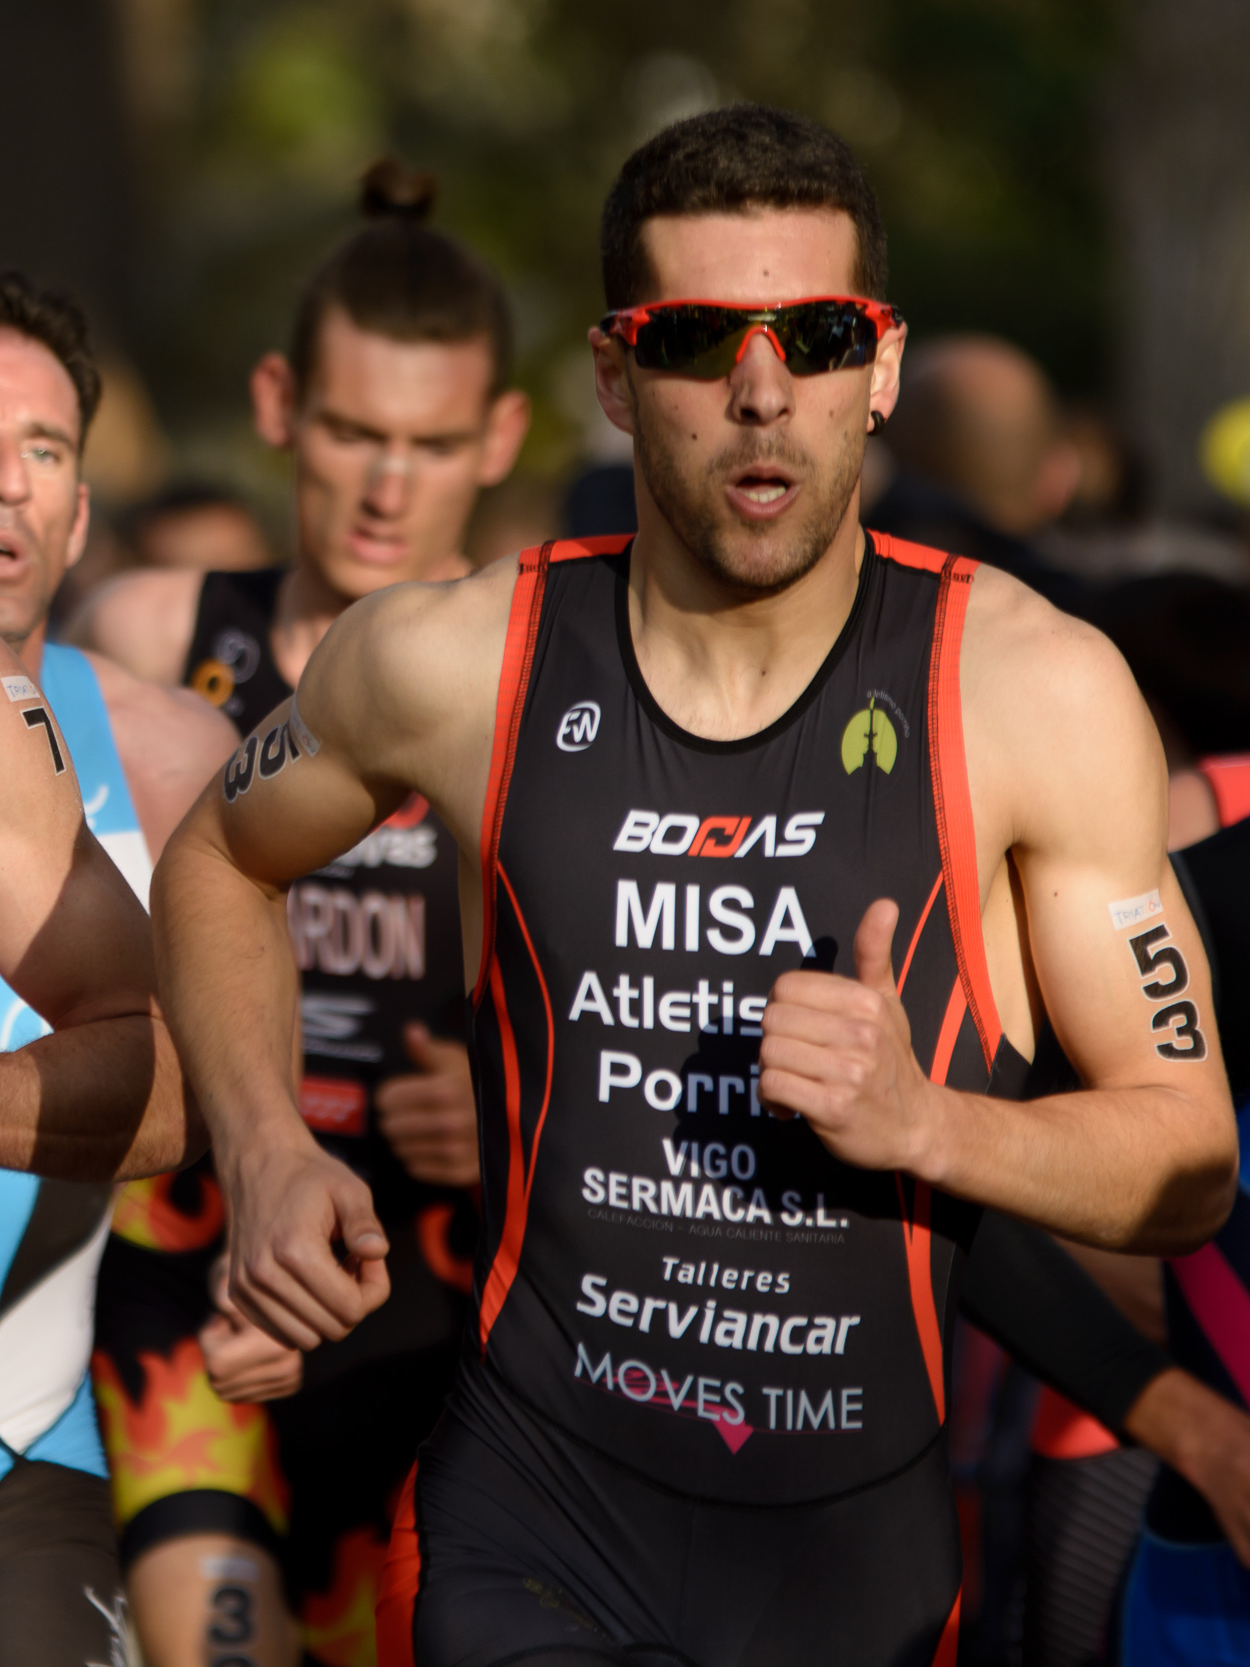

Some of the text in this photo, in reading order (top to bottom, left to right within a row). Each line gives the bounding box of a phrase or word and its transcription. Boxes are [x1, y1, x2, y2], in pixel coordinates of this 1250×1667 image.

[20, 706, 66, 776] 7
[614, 879, 817, 958] MISA
[568, 970, 766, 1037] Atletis
[598, 1049, 762, 1118] Porri
[662, 1137, 756, 1181] VIGO
[581, 1167, 850, 1229] SERMACA S.L.
[662, 1257, 790, 1294] Talleres
[576, 1273, 861, 1357] Serviancar
[574, 1342, 864, 1431] MOVES TIME
